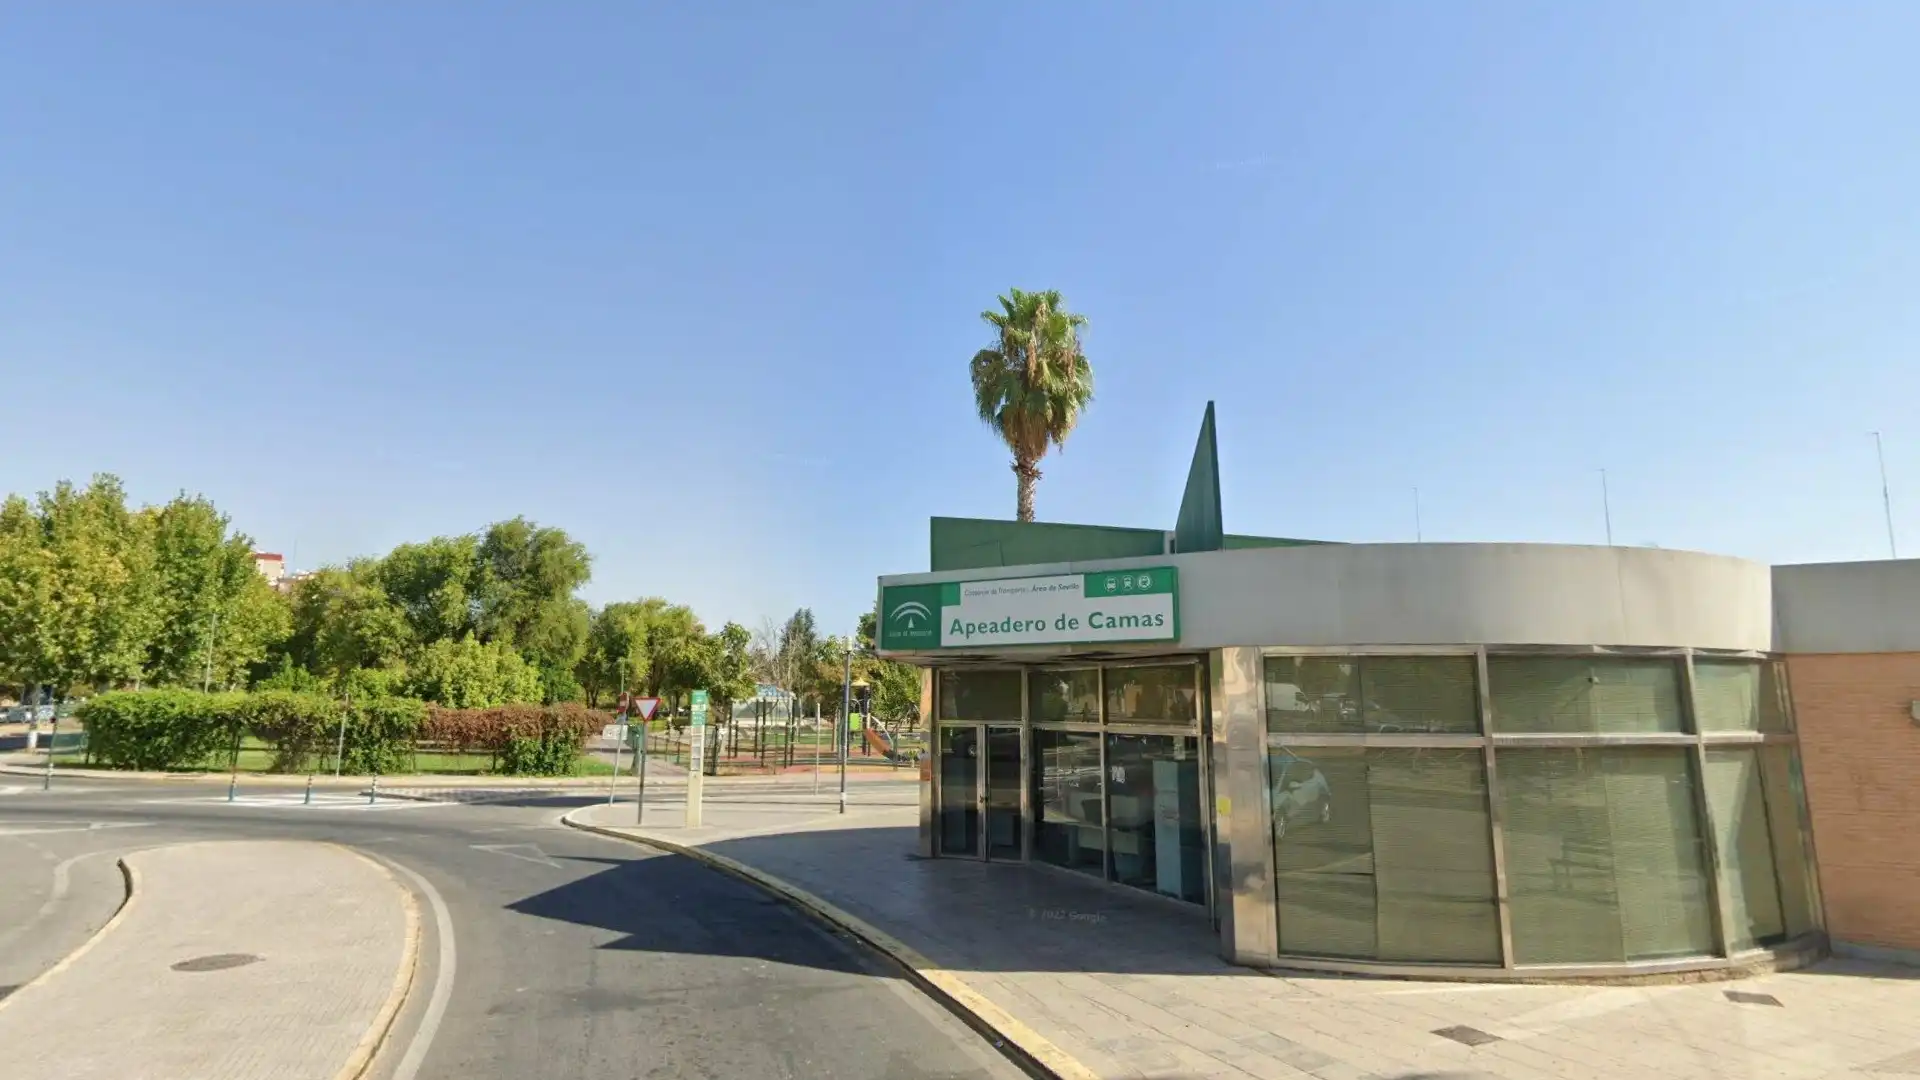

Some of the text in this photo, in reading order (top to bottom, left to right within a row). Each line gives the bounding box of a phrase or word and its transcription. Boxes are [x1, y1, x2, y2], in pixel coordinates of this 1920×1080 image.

[950, 616, 1046, 639] Apeadero
[1054, 613, 1079, 631] de
[1088, 611, 1164, 630] Camas
